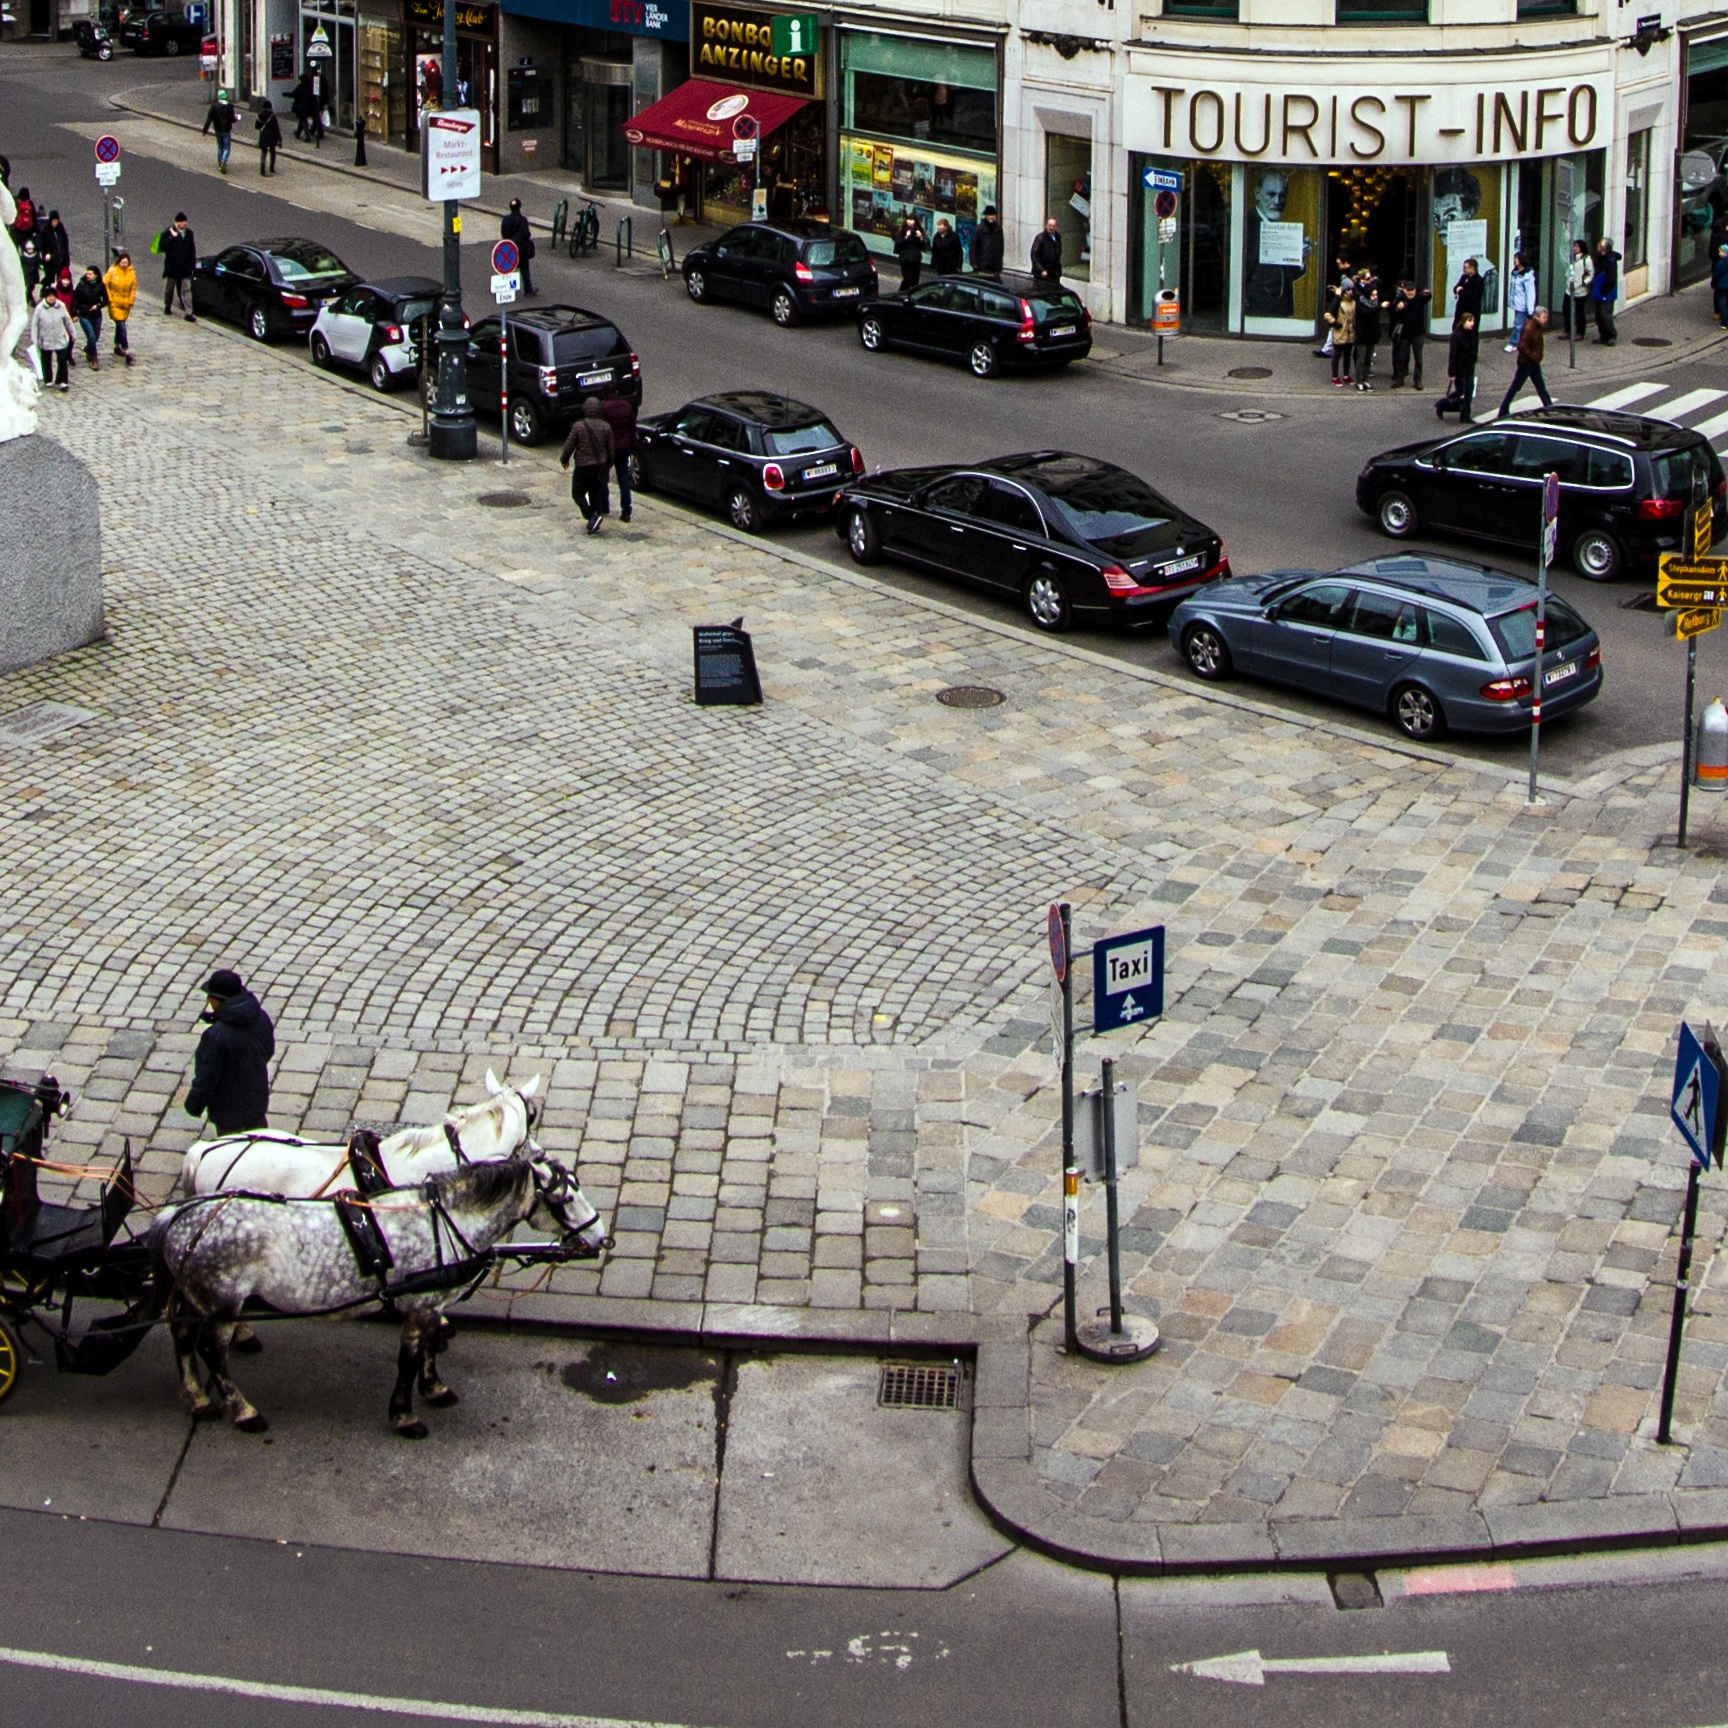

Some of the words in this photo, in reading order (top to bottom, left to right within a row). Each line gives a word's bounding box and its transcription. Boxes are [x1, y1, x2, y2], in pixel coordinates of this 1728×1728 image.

[645, 3, 658, 13] VIER
[645, 19, 661, 30] BANK
[700, 43, 807, 82] ANZINGER
[444, 140, 467, 149] Markt-
[436, 150, 473, 160] Restaurant
[1154, 175, 1177, 186] EINBAHN
[1109, 950, 1149, 981] Taxi
